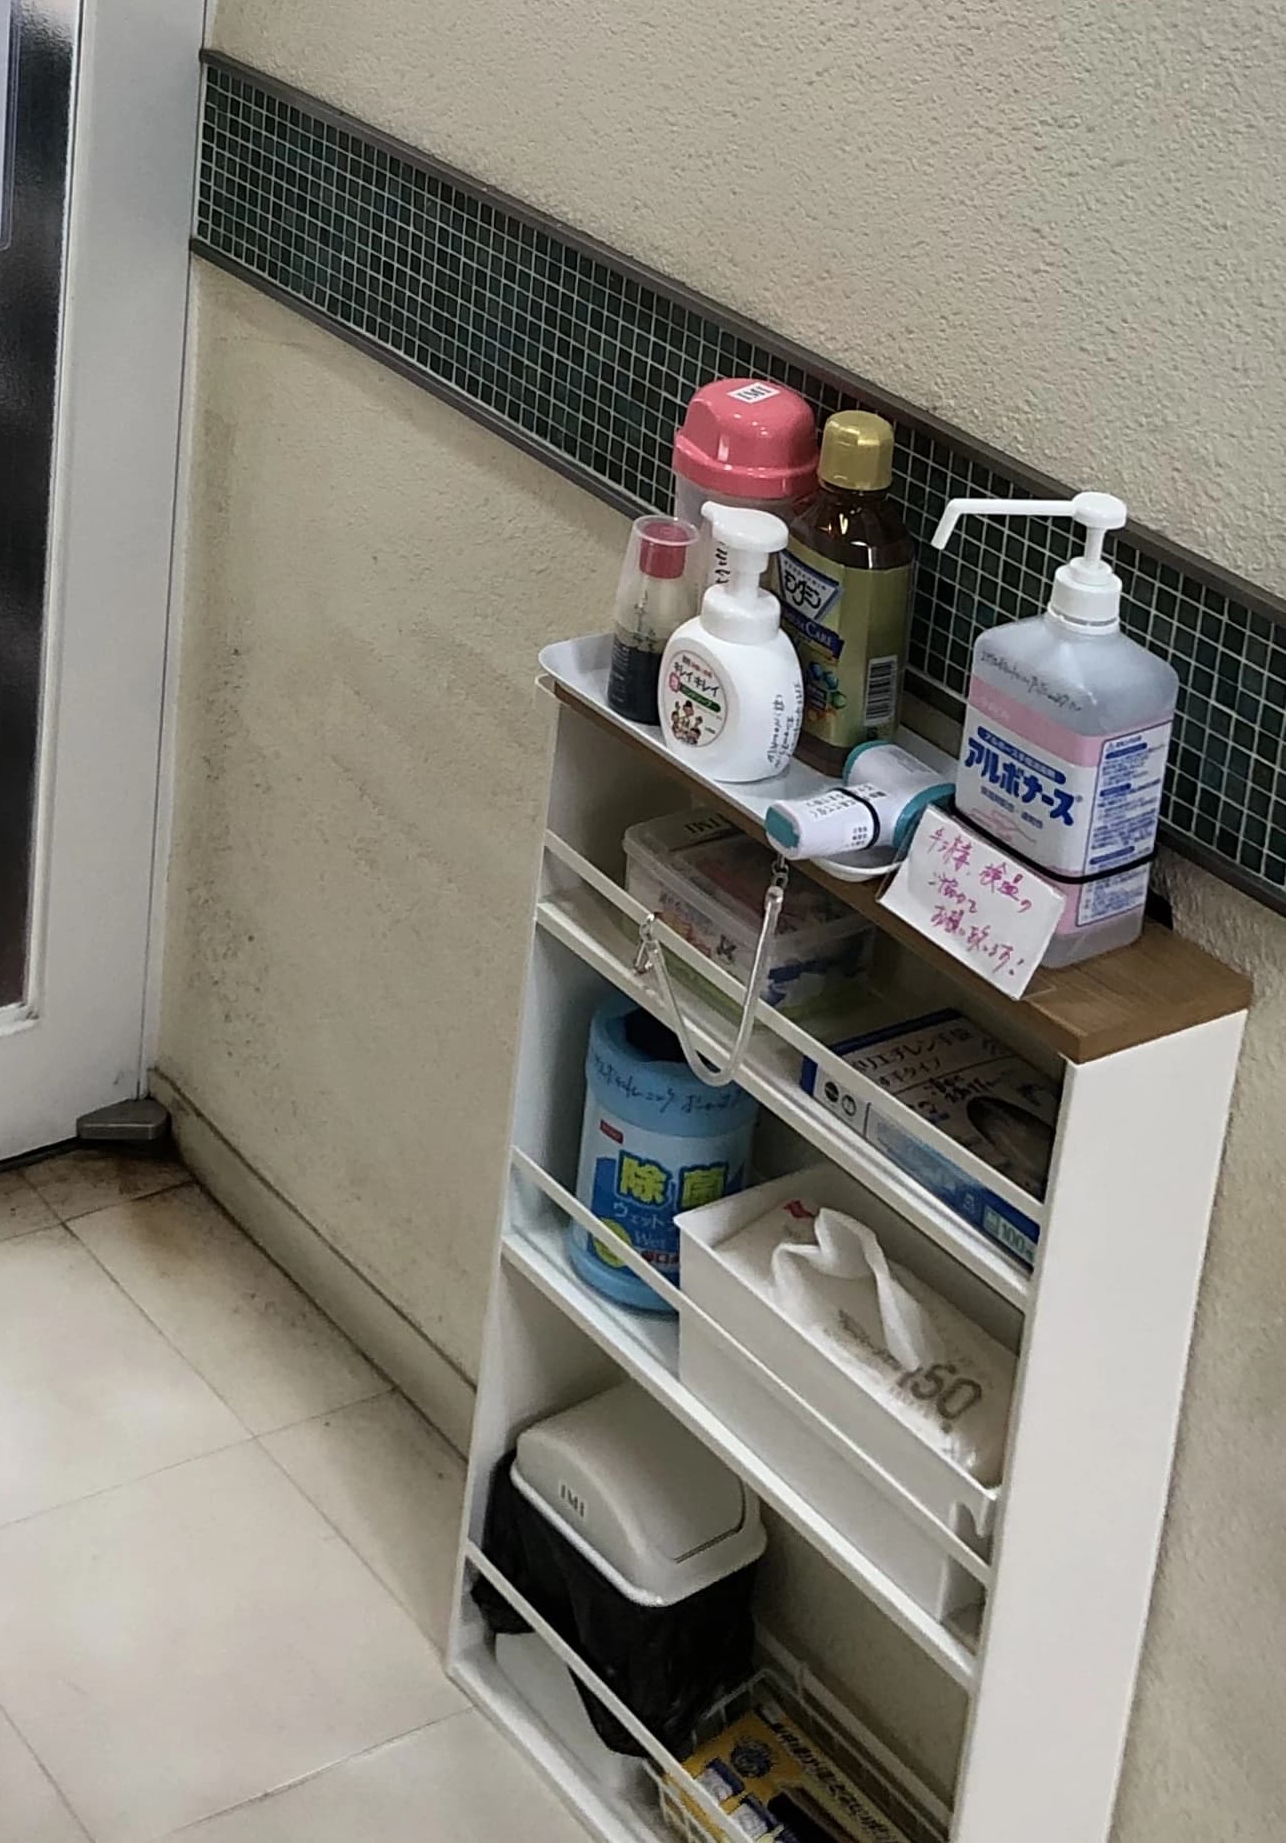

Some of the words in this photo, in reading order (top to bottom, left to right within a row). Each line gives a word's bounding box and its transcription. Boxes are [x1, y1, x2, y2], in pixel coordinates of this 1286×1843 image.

[672, 659, 721, 698] キレイキレイ
[964, 737, 1075, 826] アルボナース
